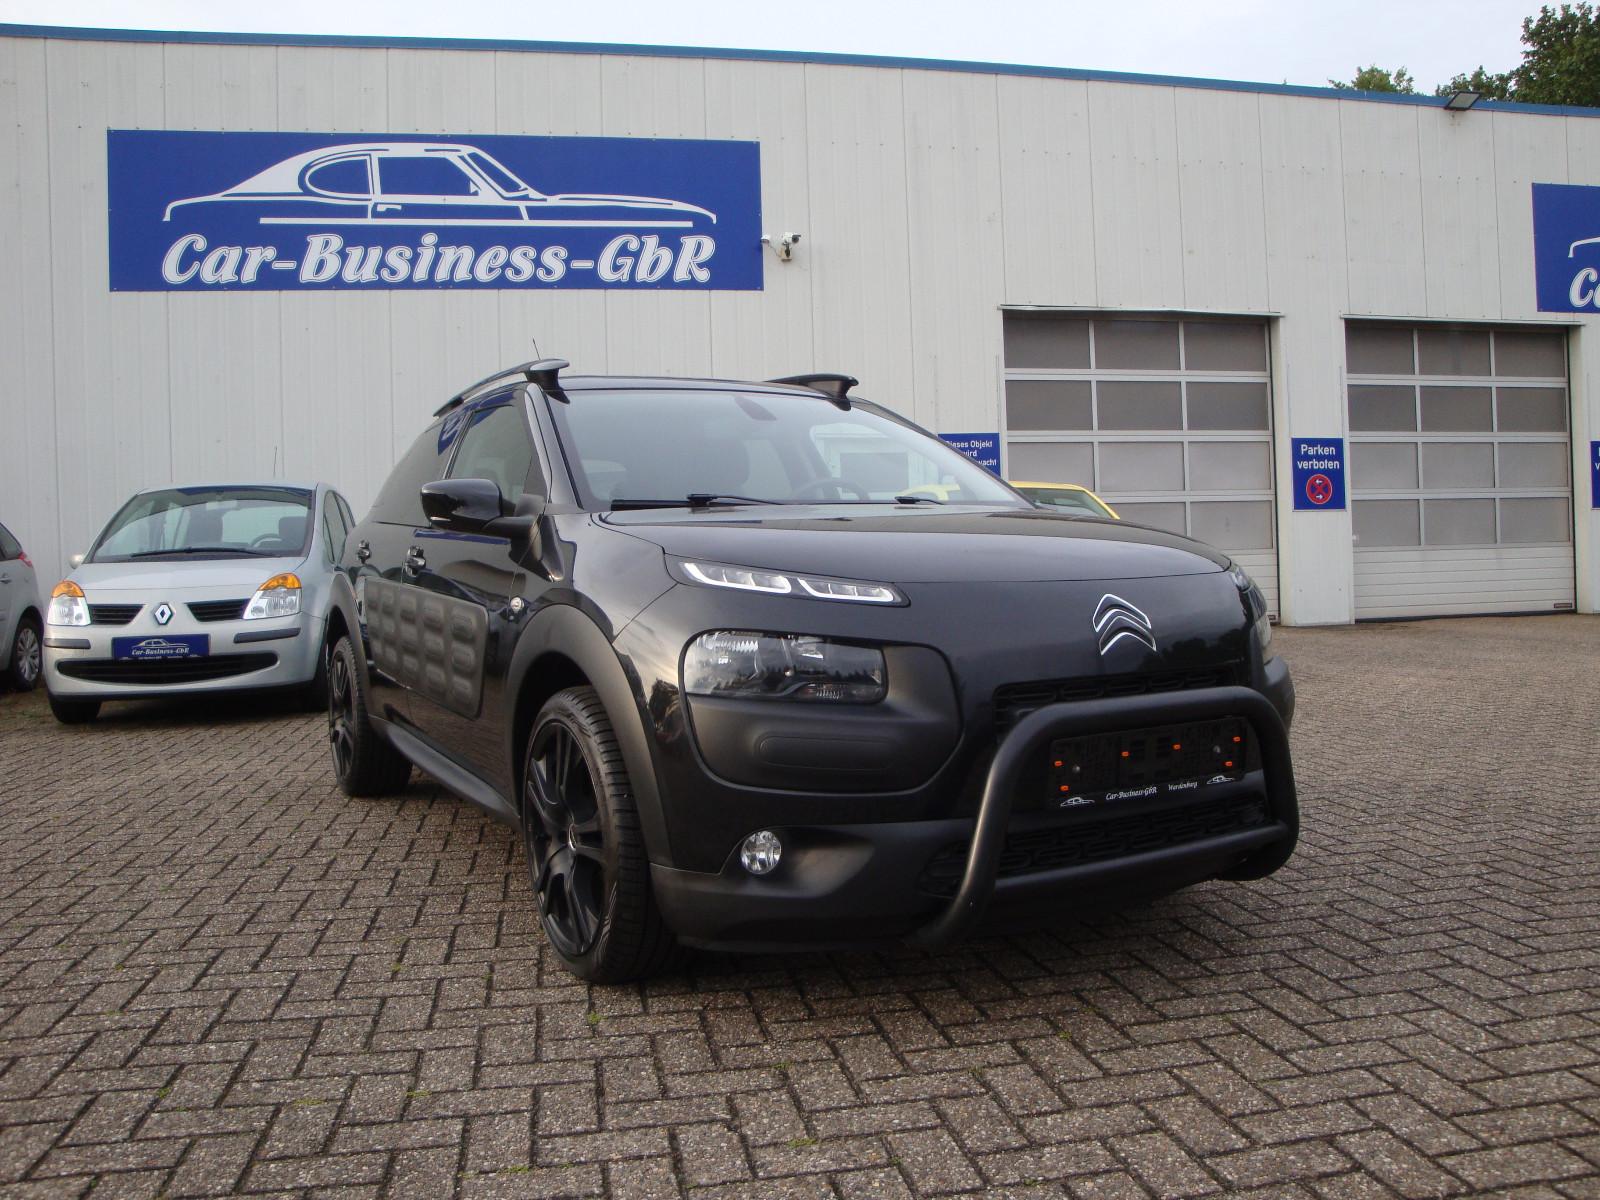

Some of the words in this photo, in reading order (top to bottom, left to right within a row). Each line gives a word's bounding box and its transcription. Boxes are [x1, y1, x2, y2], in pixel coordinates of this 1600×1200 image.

[161, 232, 716, 285] Car-Business-GbR
[970, 440, 993, 449] Objekt
[1300, 444, 1336, 455] Parken
[1297, 458, 1340, 470] verboten
